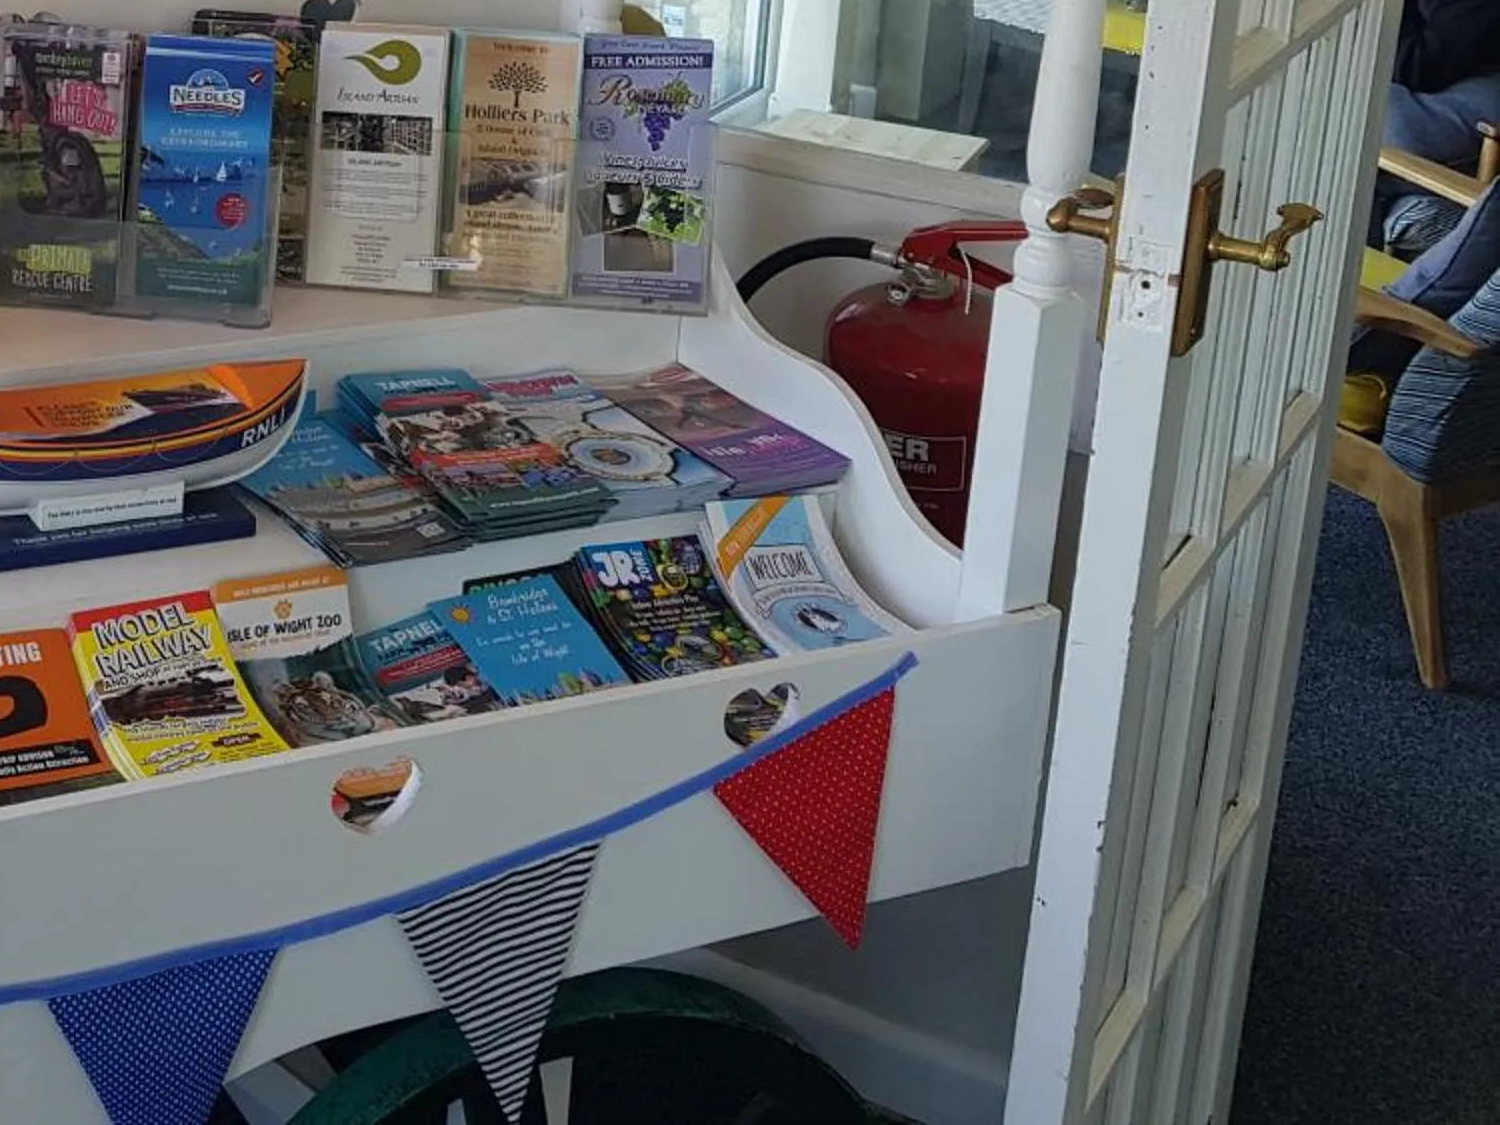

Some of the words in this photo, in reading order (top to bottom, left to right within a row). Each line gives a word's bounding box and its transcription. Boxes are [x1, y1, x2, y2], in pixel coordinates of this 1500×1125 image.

[592, 56, 622, 68] FREE
[626, 55, 703, 68] ADMISSION!
[173, 88, 242, 106] NEEDLES
[532, 108, 570, 126] Park
[241, 406, 285, 447] RNLI
[592, 549, 640, 587] JR
[749, 551, 814, 581] WELCOME
[92, 601, 197, 650] MODEL
[227, 626, 251, 644] ISLE
[254, 624, 270, 638] OF
[273, 617, 314, 636] WIGHT
[316, 613, 342, 629] ZOO
[368, 618, 444, 653] TAPNEL
[94, 624, 213, 678] RAILWAY
[103, 676, 129, 692] AND
